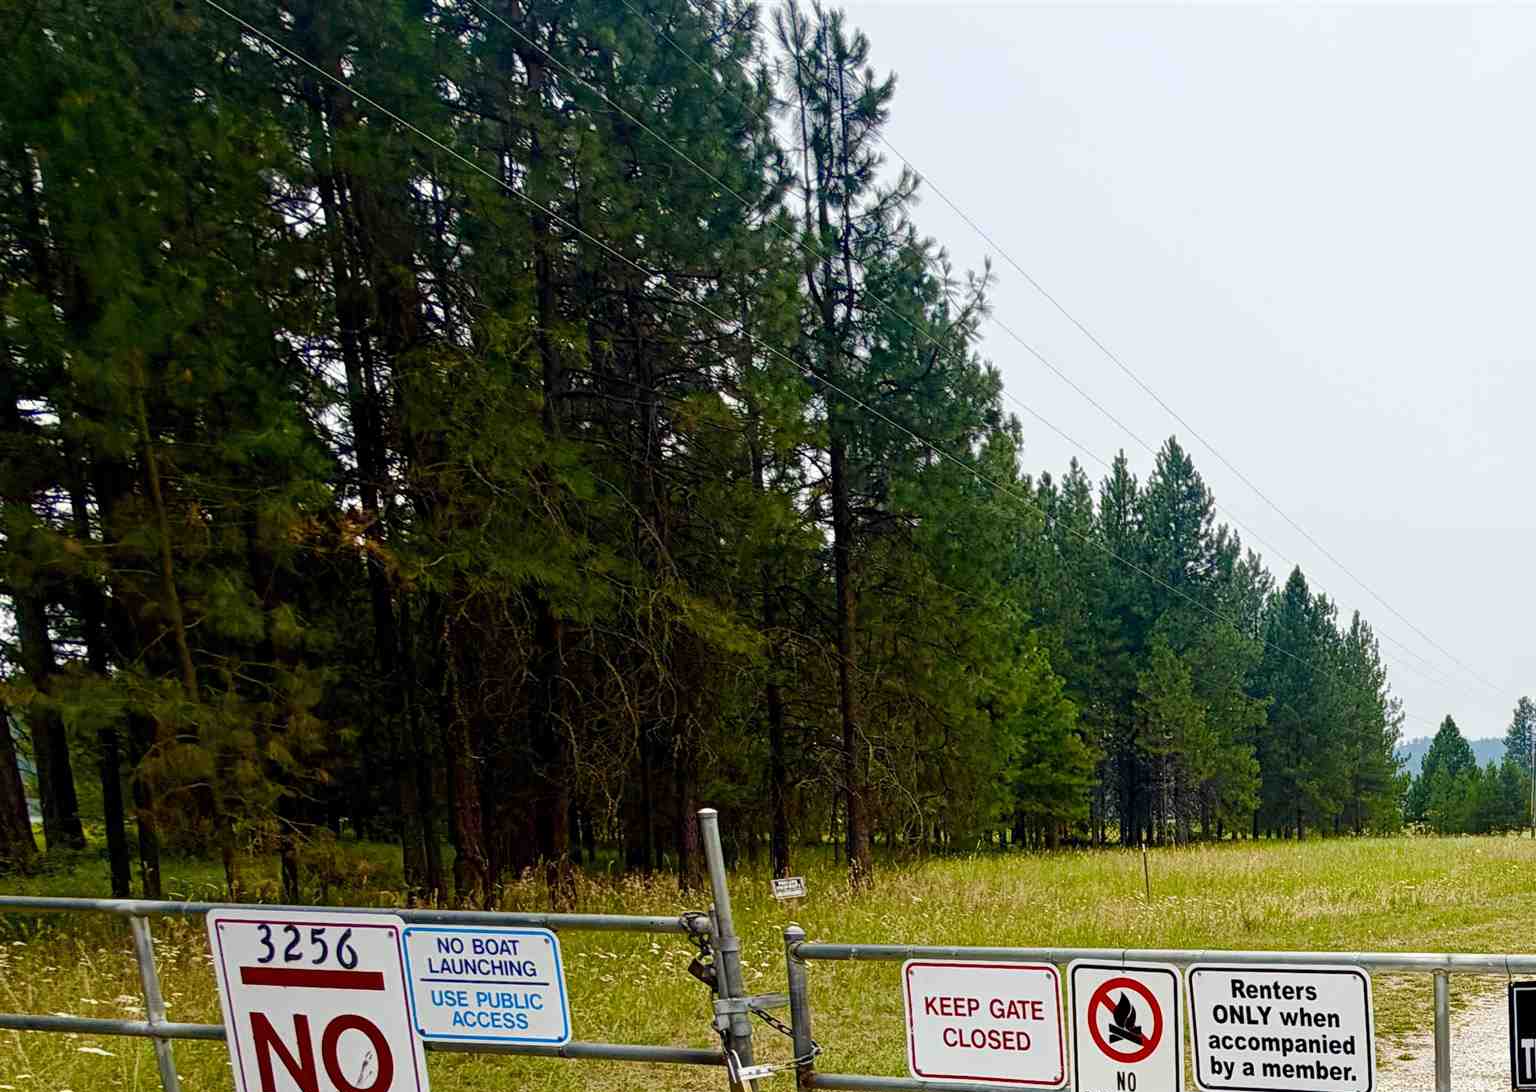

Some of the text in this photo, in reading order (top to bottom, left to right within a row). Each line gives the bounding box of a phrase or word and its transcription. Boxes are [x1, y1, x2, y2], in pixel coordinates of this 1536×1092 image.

[257, 923, 359, 970] 3256
[437, 937, 519, 956] NO BOAT
[428, 958, 537, 977] LAUNCHING
[431, 990, 544, 1010] USE PUBLIC
[1231, 979, 1317, 1001] Renters
[924, 996, 1044, 1021] KEEP GATE
[1213, 1004, 1340, 1028] ONLY when
[452, 1011, 529, 1029] ACCESS
[943, 1028, 1031, 1051] CLOSED
[1208, 1033, 1356, 1062] accompanied
[1211, 1055, 1357, 1083] by a member.
[1116, 1071, 1137, 1091] NO
